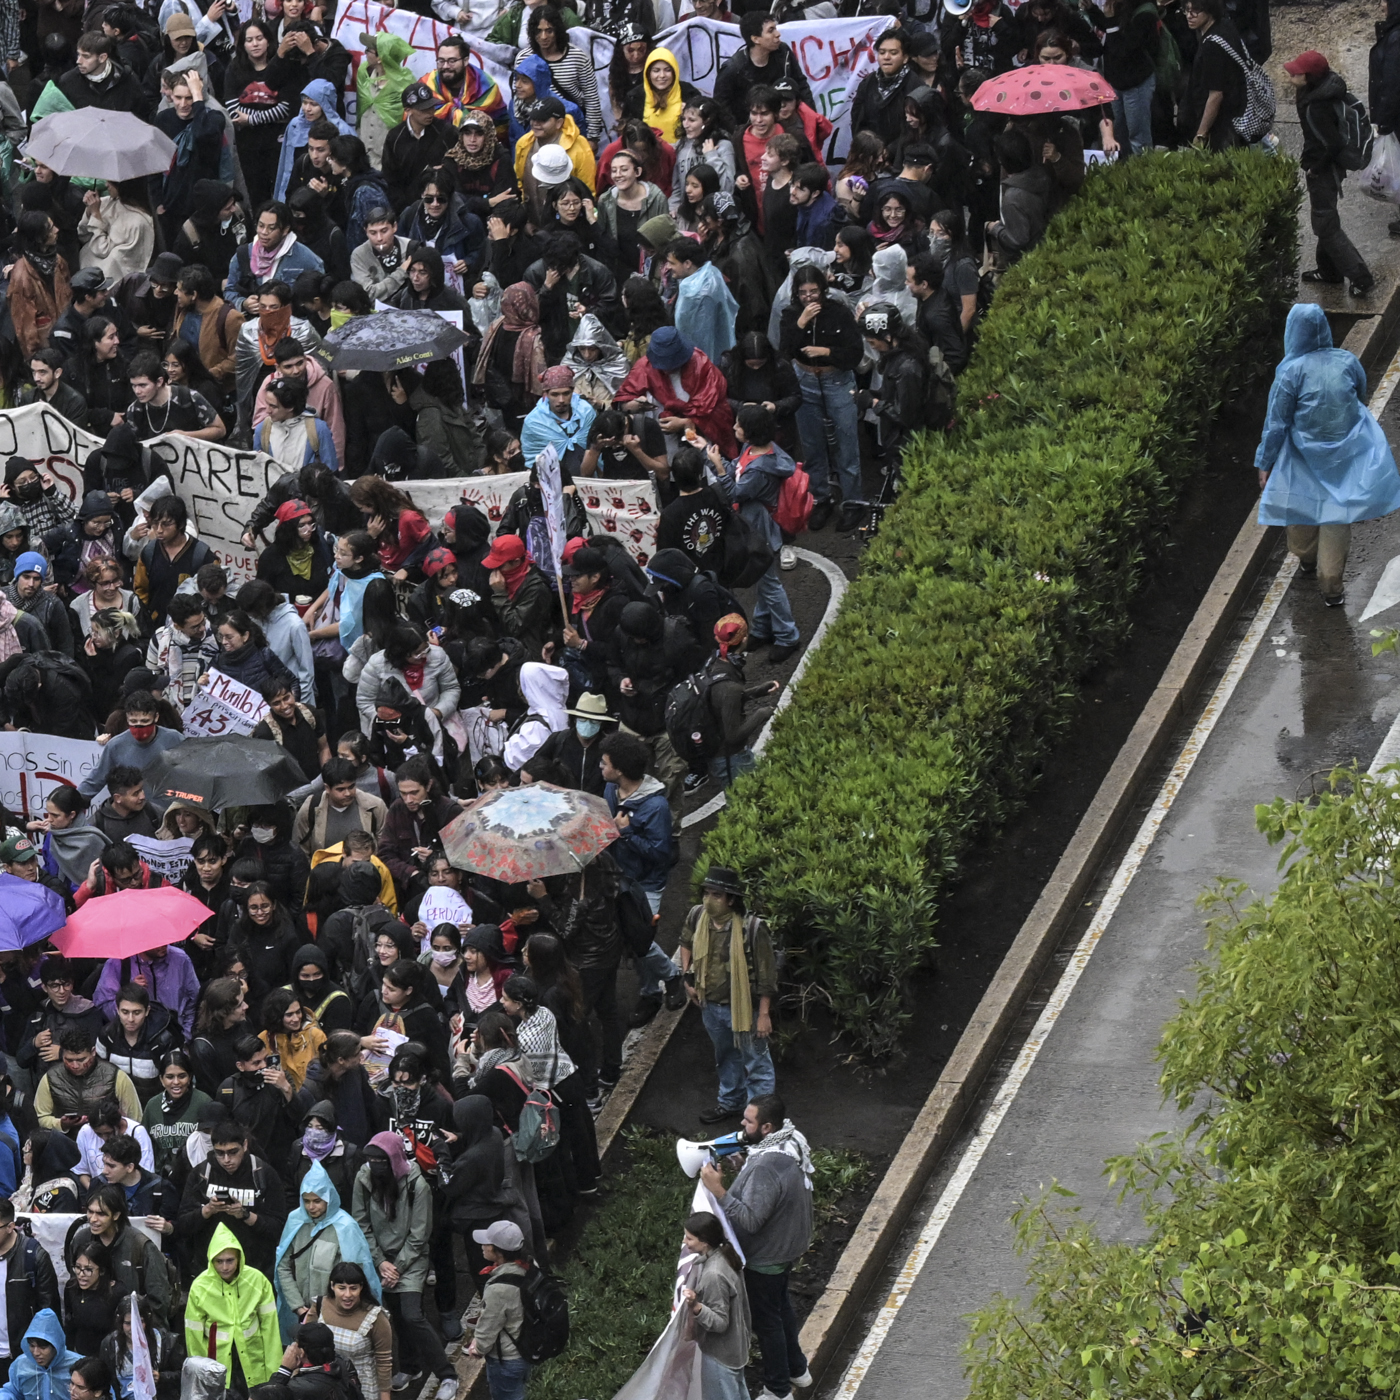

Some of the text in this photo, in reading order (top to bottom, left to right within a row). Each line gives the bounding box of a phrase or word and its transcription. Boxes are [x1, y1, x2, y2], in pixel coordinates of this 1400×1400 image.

[396, 350, 434, 365] Aldo Conti
[684, 512, 700, 531] THE
[174, 791, 204, 803] TRUPER
